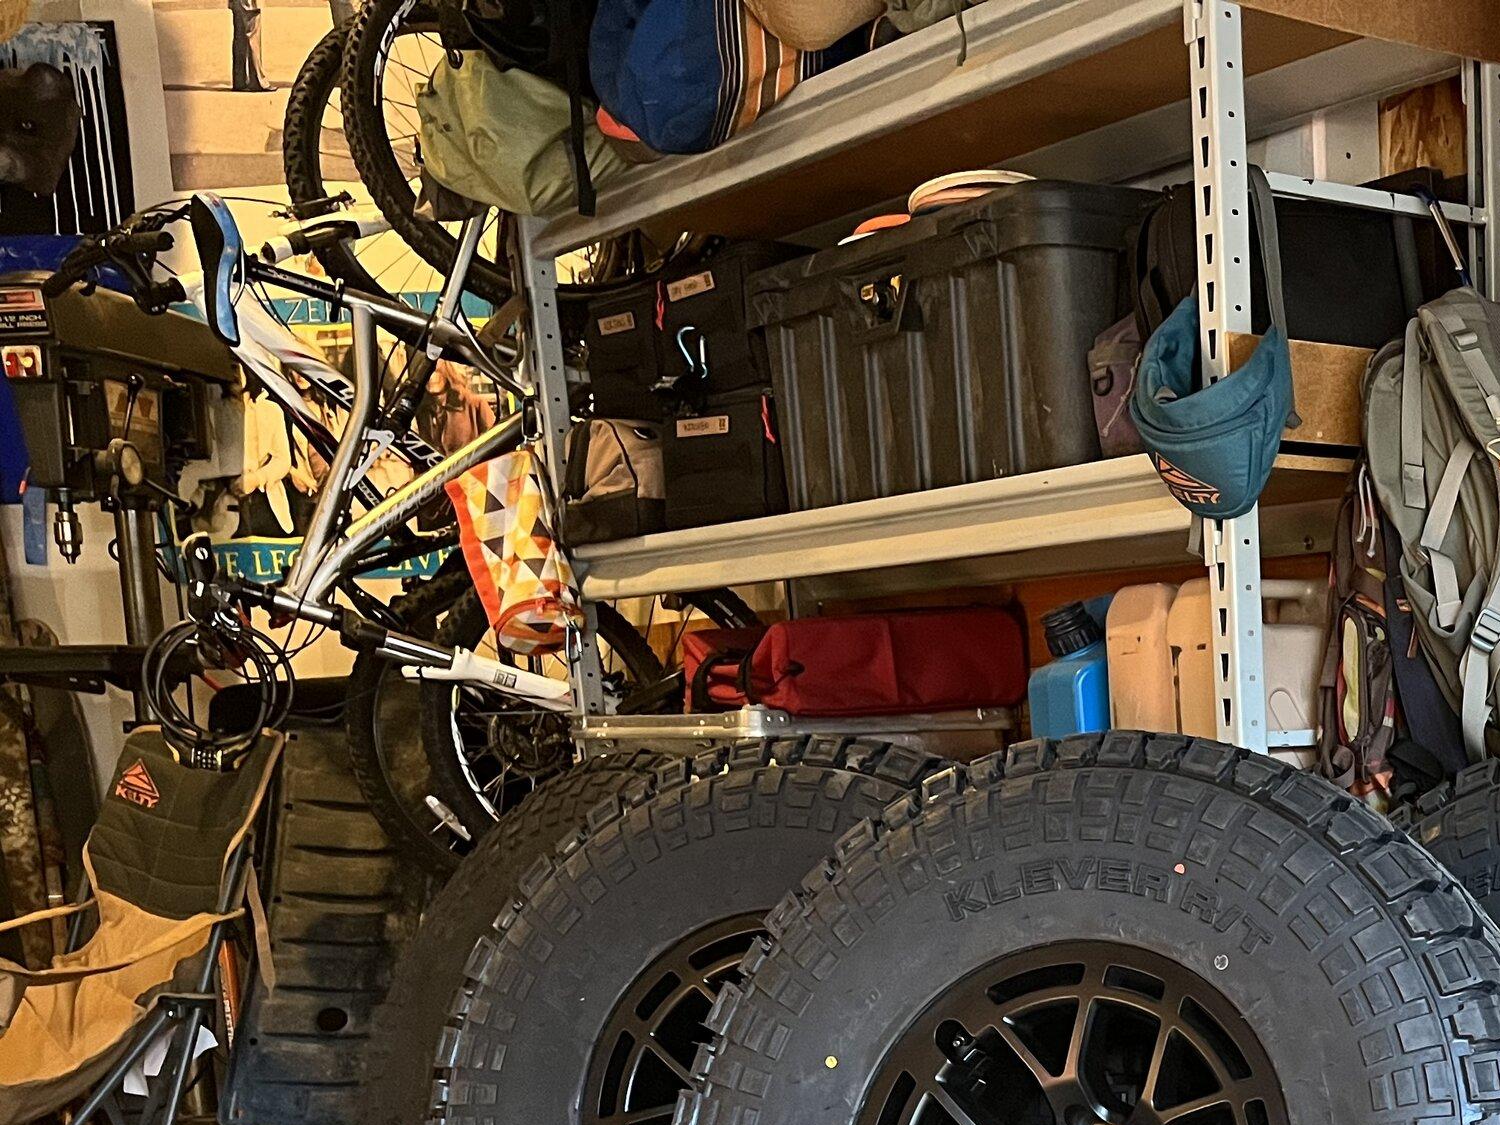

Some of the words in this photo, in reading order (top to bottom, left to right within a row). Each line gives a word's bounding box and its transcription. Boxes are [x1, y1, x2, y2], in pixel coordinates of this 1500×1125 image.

[115, 784, 160, 809] KELTY
[942, 856, 1171, 922] KLEVER
[1180, 879, 1274, 955] R/T
